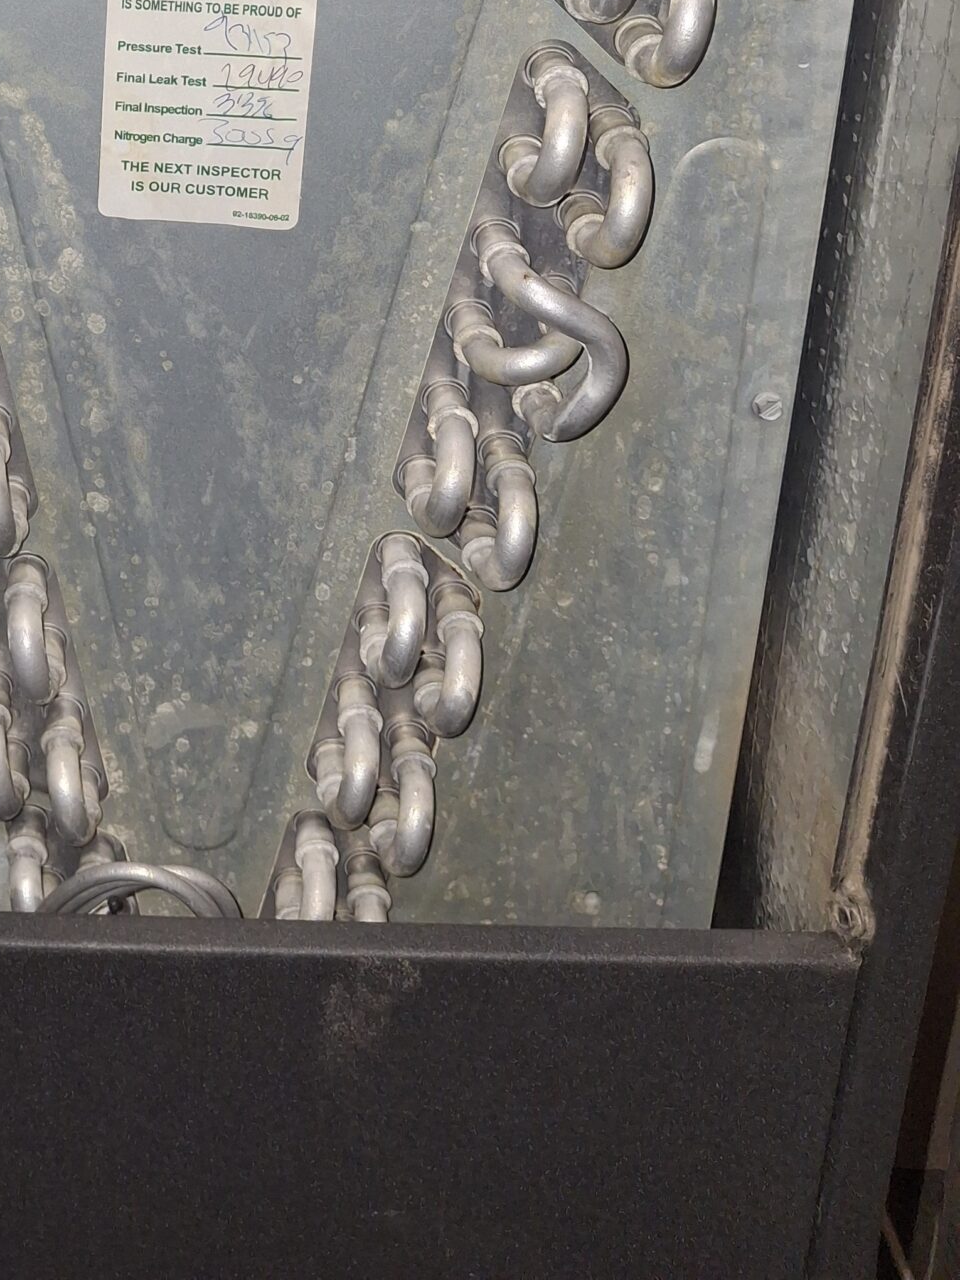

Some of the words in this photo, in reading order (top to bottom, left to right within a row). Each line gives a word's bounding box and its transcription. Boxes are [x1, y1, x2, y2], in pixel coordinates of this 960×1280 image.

[135, 0, 202, 13] SOMETHING
[205, 2, 221, 14] TO
[223, 3, 239, 15] BE
[242, 4, 283, 17] PROUD
[286, 6, 302, 19] OF
[117, 40, 172, 55] Pressure
[175, 43, 202, 55] Test
[116, 72, 146, 84] Final
[148, 73, 178, 86] Leak
[180, 75, 207, 88] Test
[114, 101, 142, 113] Final
[143, 102, 203, 120] Inspection
[114, 130, 160, 145] Nitrogen
[162, 132, 203, 147] Charge
[121, 160, 149, 173] THE
[153, 161, 192, 175] NEXT
[196, 164, 281, 180] INSPECTOR
[131, 180, 144, 192] IS
[148, 181, 181, 194] OUR
[185, 183, 269, 200] CUSTOMER
